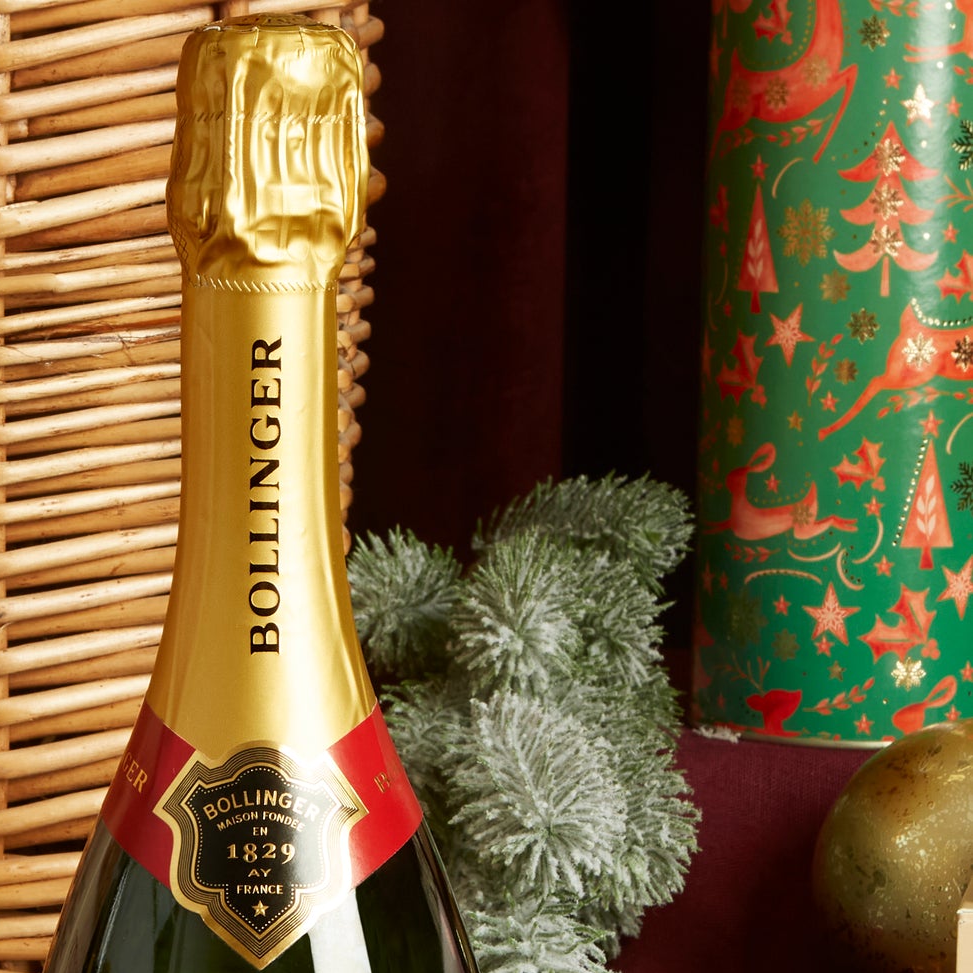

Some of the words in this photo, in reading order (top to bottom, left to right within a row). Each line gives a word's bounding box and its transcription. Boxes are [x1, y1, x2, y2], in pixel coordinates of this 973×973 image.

[249, 335, 282, 656] BOLLINGER
[203, 789, 320, 822] BOLLINGER
[217, 811, 259, 832] MAISON
[252, 826, 268, 836] EN
[227, 842, 296, 865] 1829
[247, 868, 272, 878] AY
[236, 884, 284, 895] FRANCE
